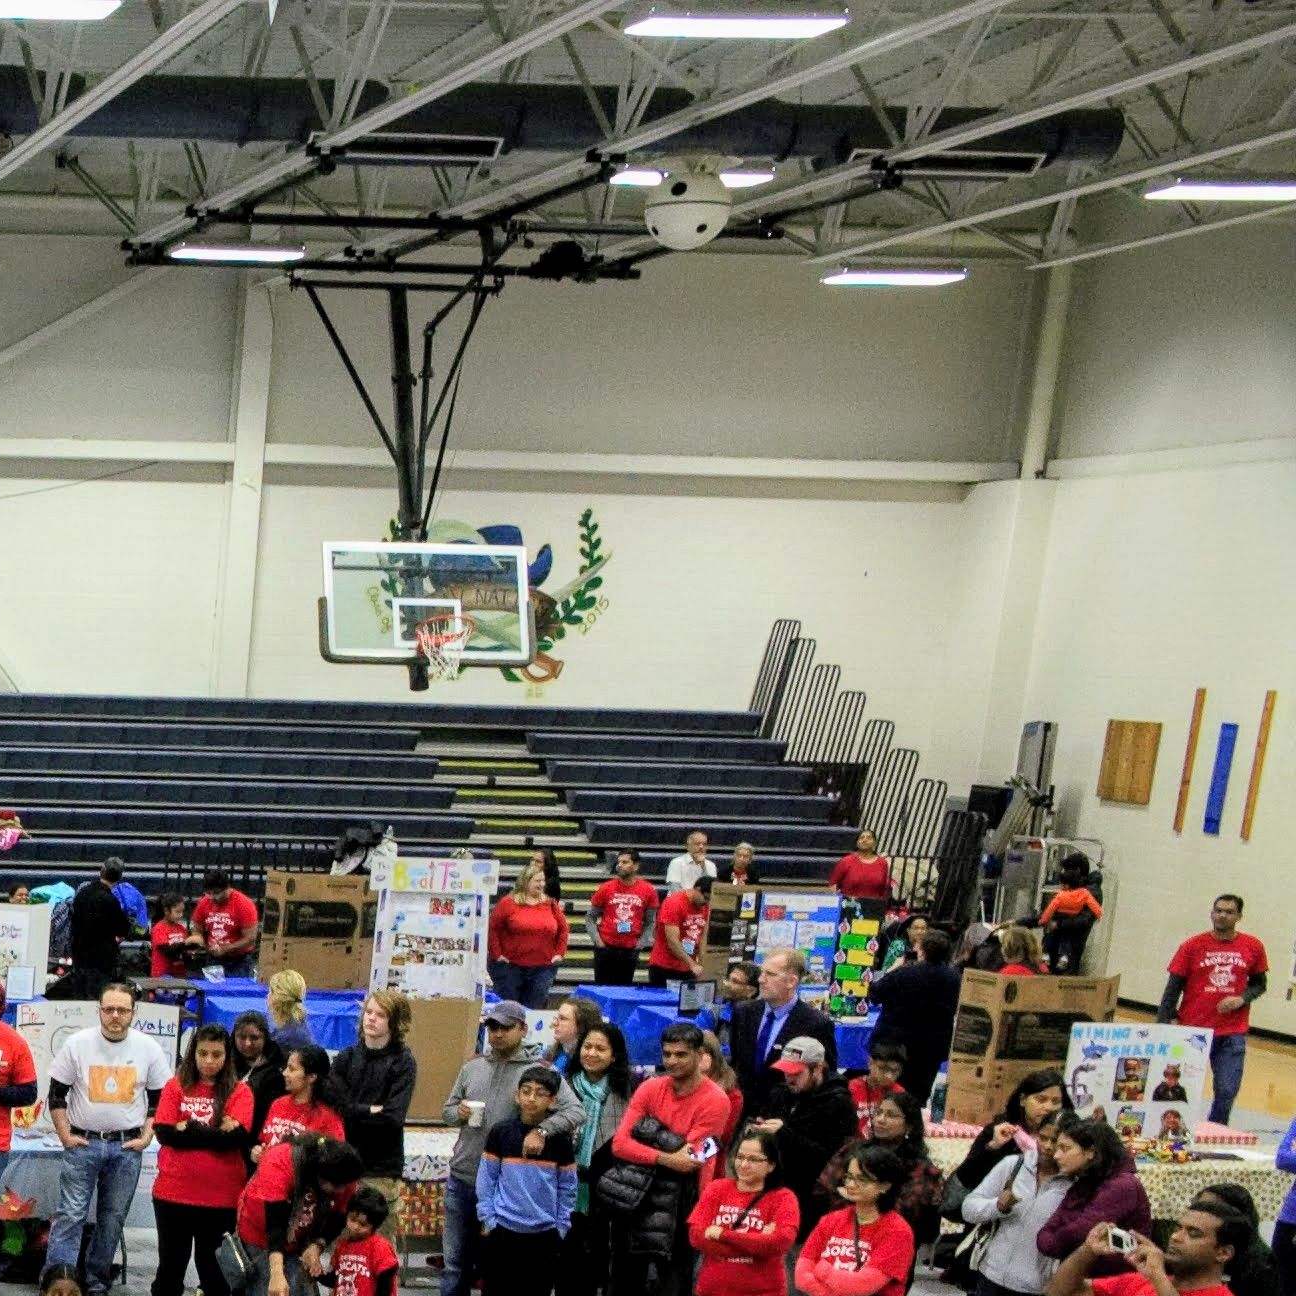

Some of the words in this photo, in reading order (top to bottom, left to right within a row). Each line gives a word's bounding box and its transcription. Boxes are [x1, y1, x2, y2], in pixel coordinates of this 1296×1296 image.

[578, 597, 610, 636] 2015
[1110, 1043, 1170, 1058] SHARK
[181, 1103, 213, 1112] BOBCA
